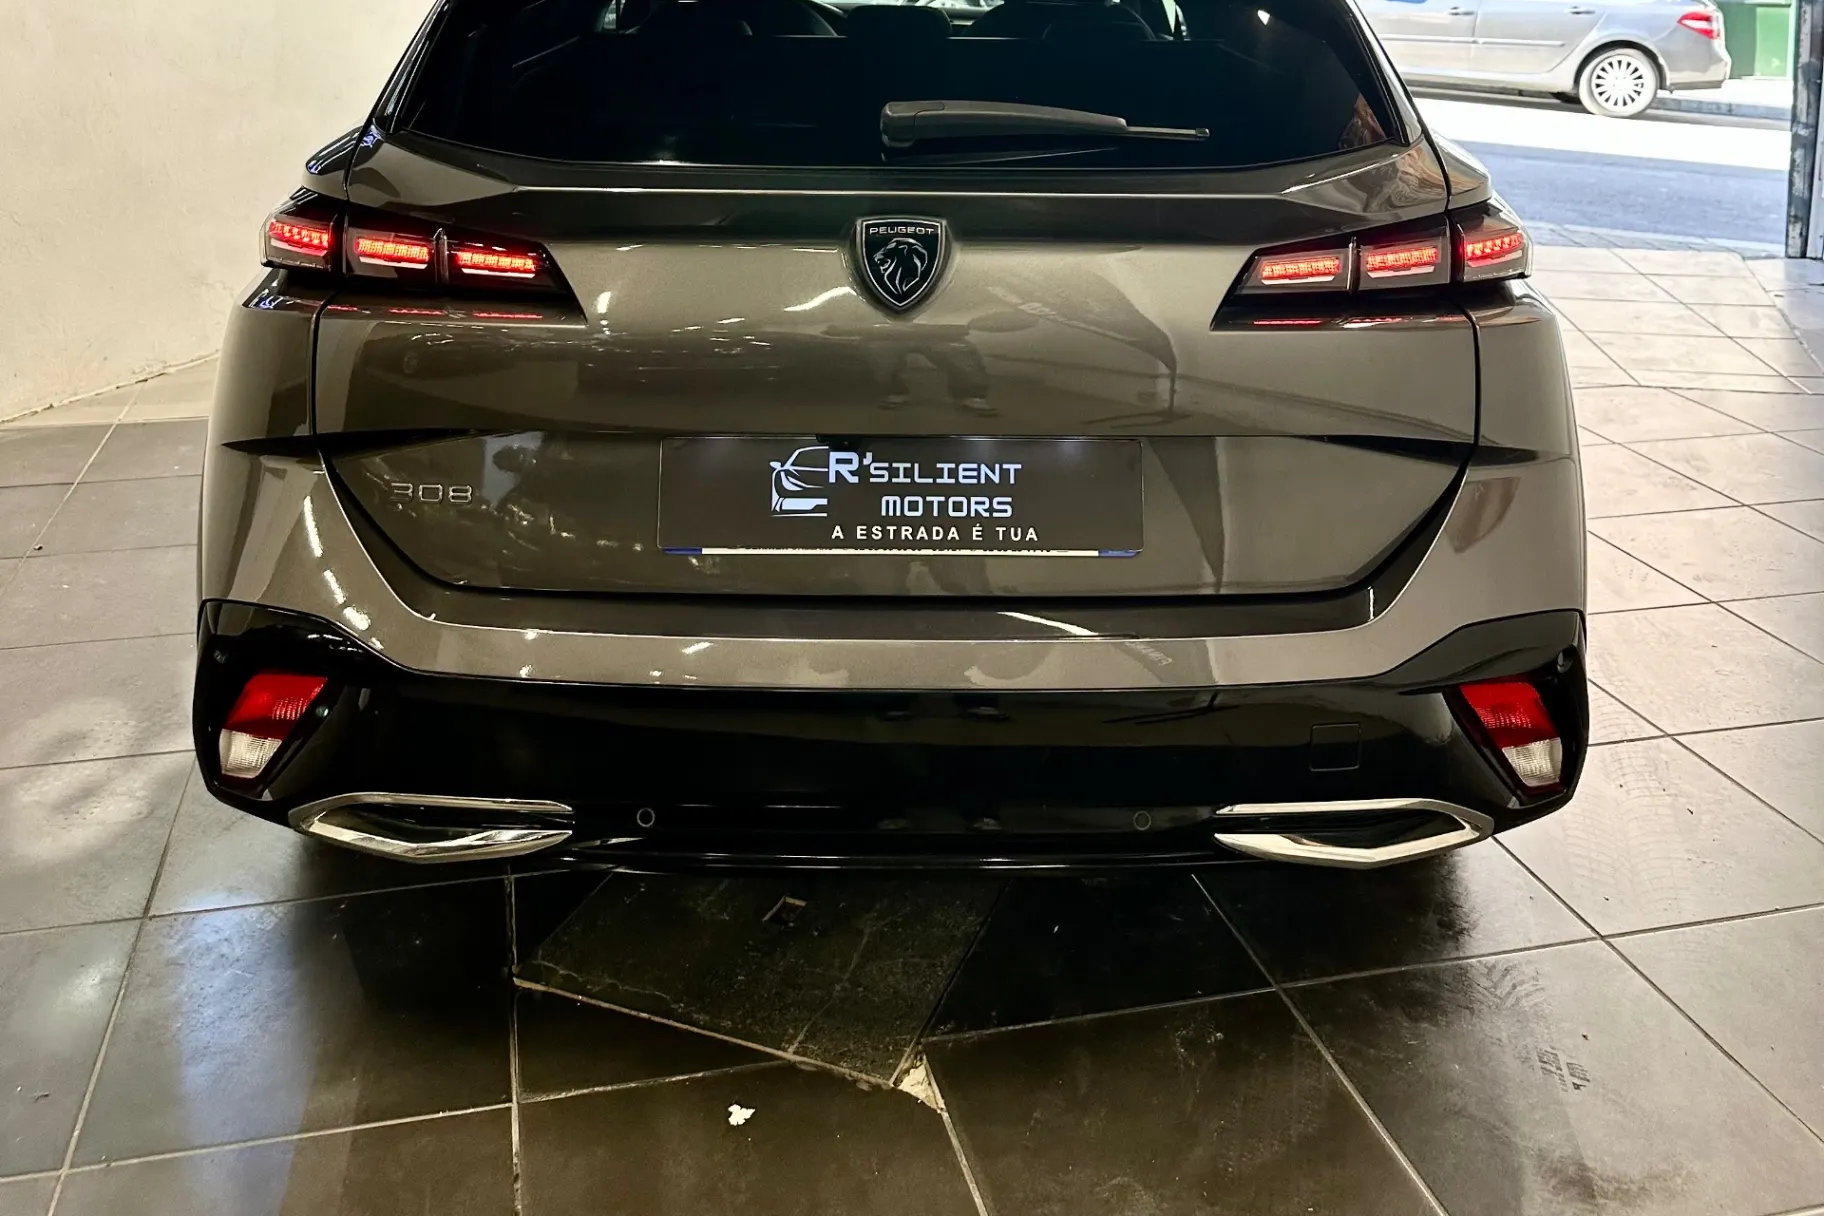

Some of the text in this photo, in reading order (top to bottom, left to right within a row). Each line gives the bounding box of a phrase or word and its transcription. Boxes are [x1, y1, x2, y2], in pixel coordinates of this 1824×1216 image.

[869, 226, 935, 235] PEUGEOT
[828, 451, 1022, 485] R'SILIENT
[390, 482, 472, 503] 308
[881, 495, 1013, 518] MOTORS
[831, 523, 1039, 542] A ESTRADA É TUA
